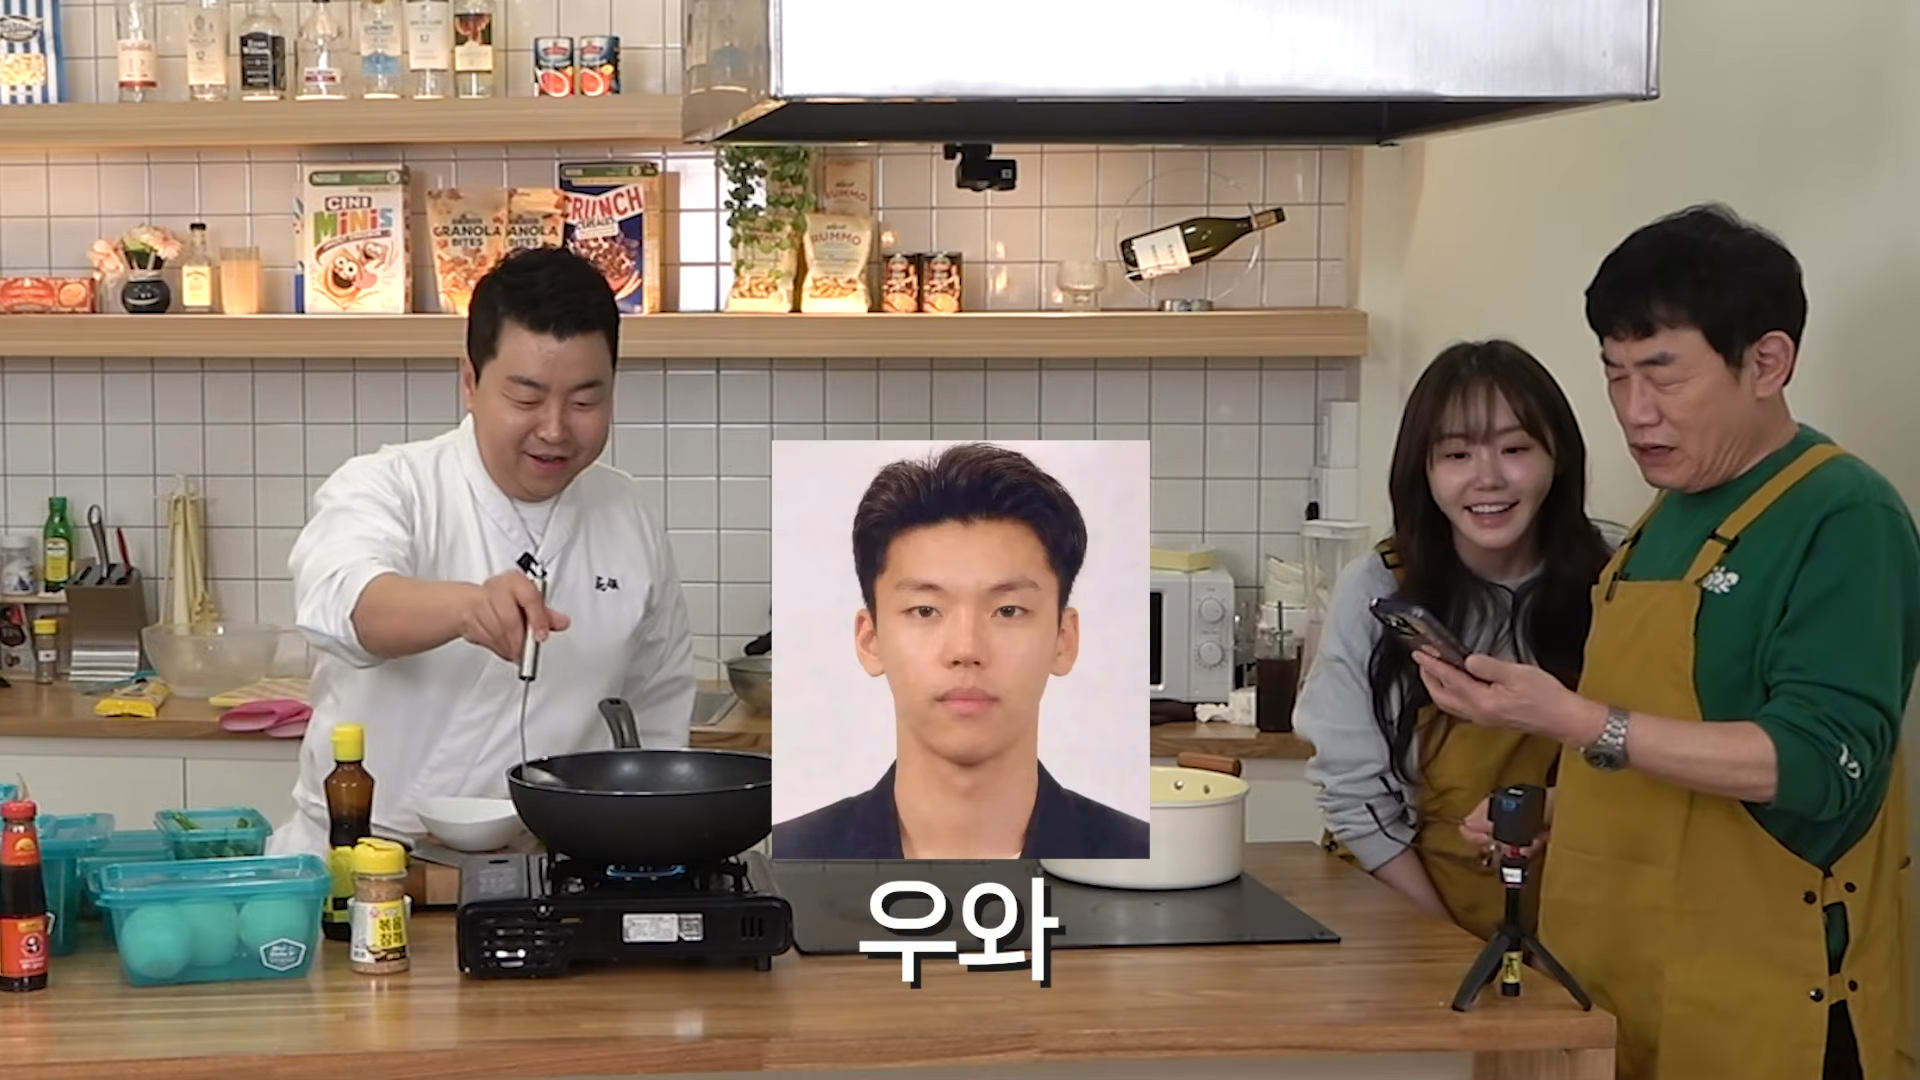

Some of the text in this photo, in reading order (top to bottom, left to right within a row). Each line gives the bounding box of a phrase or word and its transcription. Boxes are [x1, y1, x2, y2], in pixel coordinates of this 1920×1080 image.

[326, 197, 370, 210] CINI
[432, 225, 501, 237] GRANOLA
[507, 225, 559, 237] ANOLA
[451, 238, 484, 247] BITES
[507, 238, 539, 247] BITES
[810, 231, 861, 246] RUMMO
